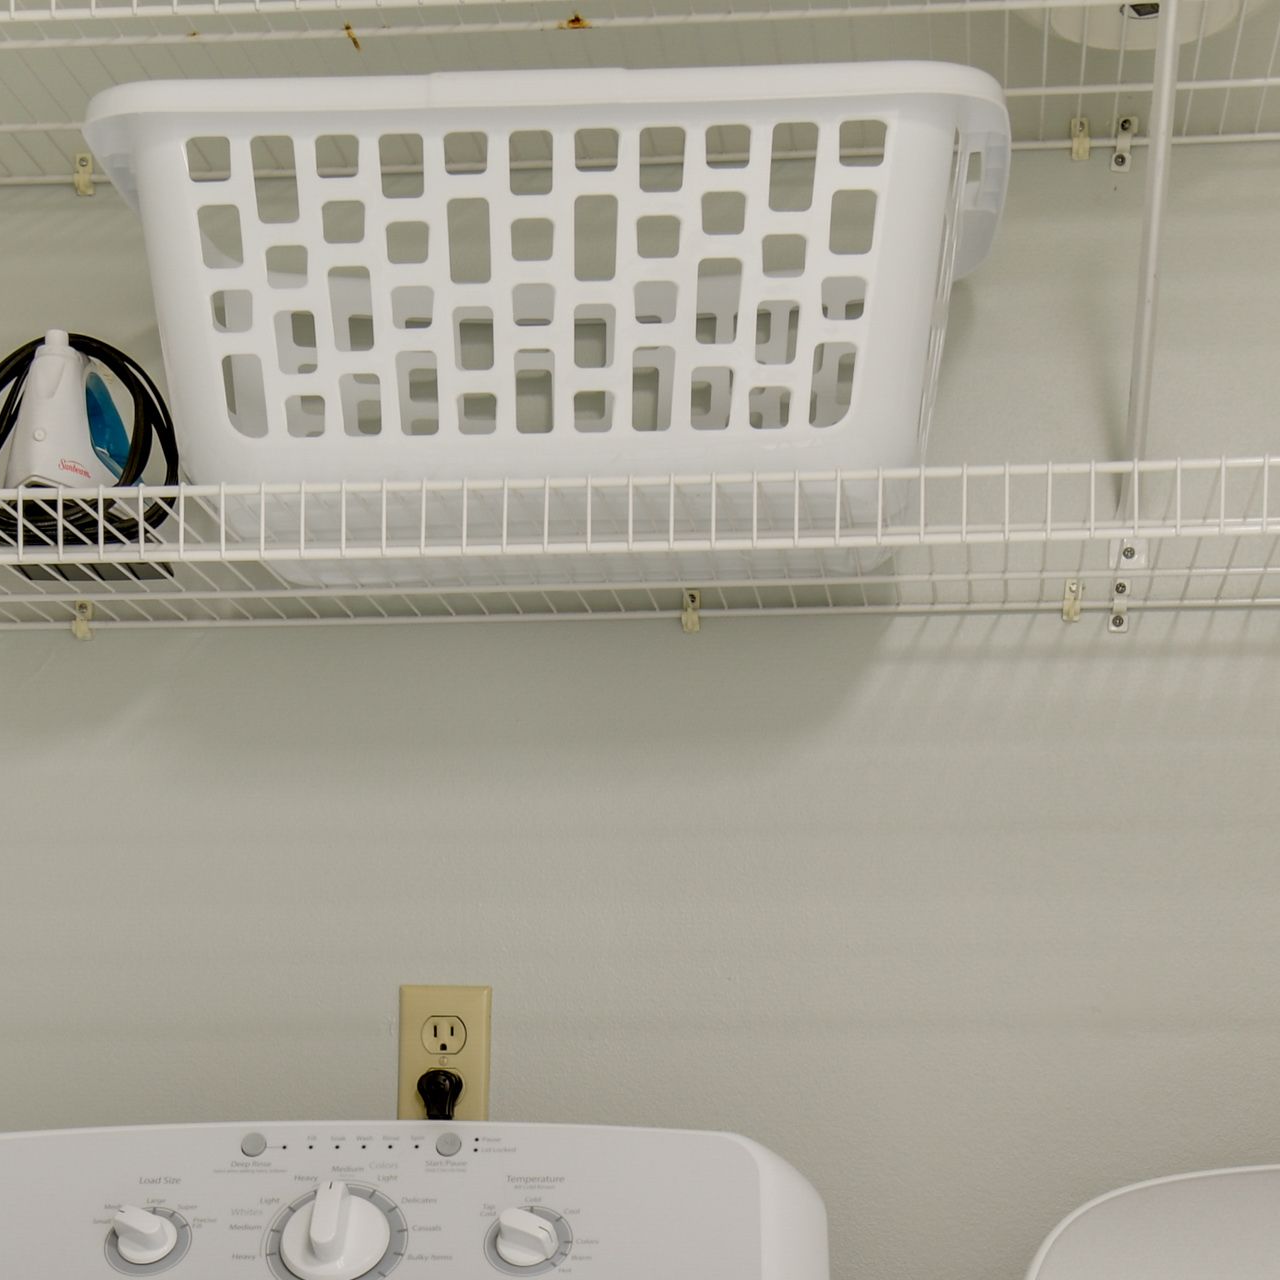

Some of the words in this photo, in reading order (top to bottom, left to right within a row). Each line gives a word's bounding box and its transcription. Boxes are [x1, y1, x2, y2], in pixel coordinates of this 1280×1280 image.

[139, 1176, 162, 1185] Load
[164, 1176, 182, 1185] Size
[506, 1175, 566, 1184] Temperature
